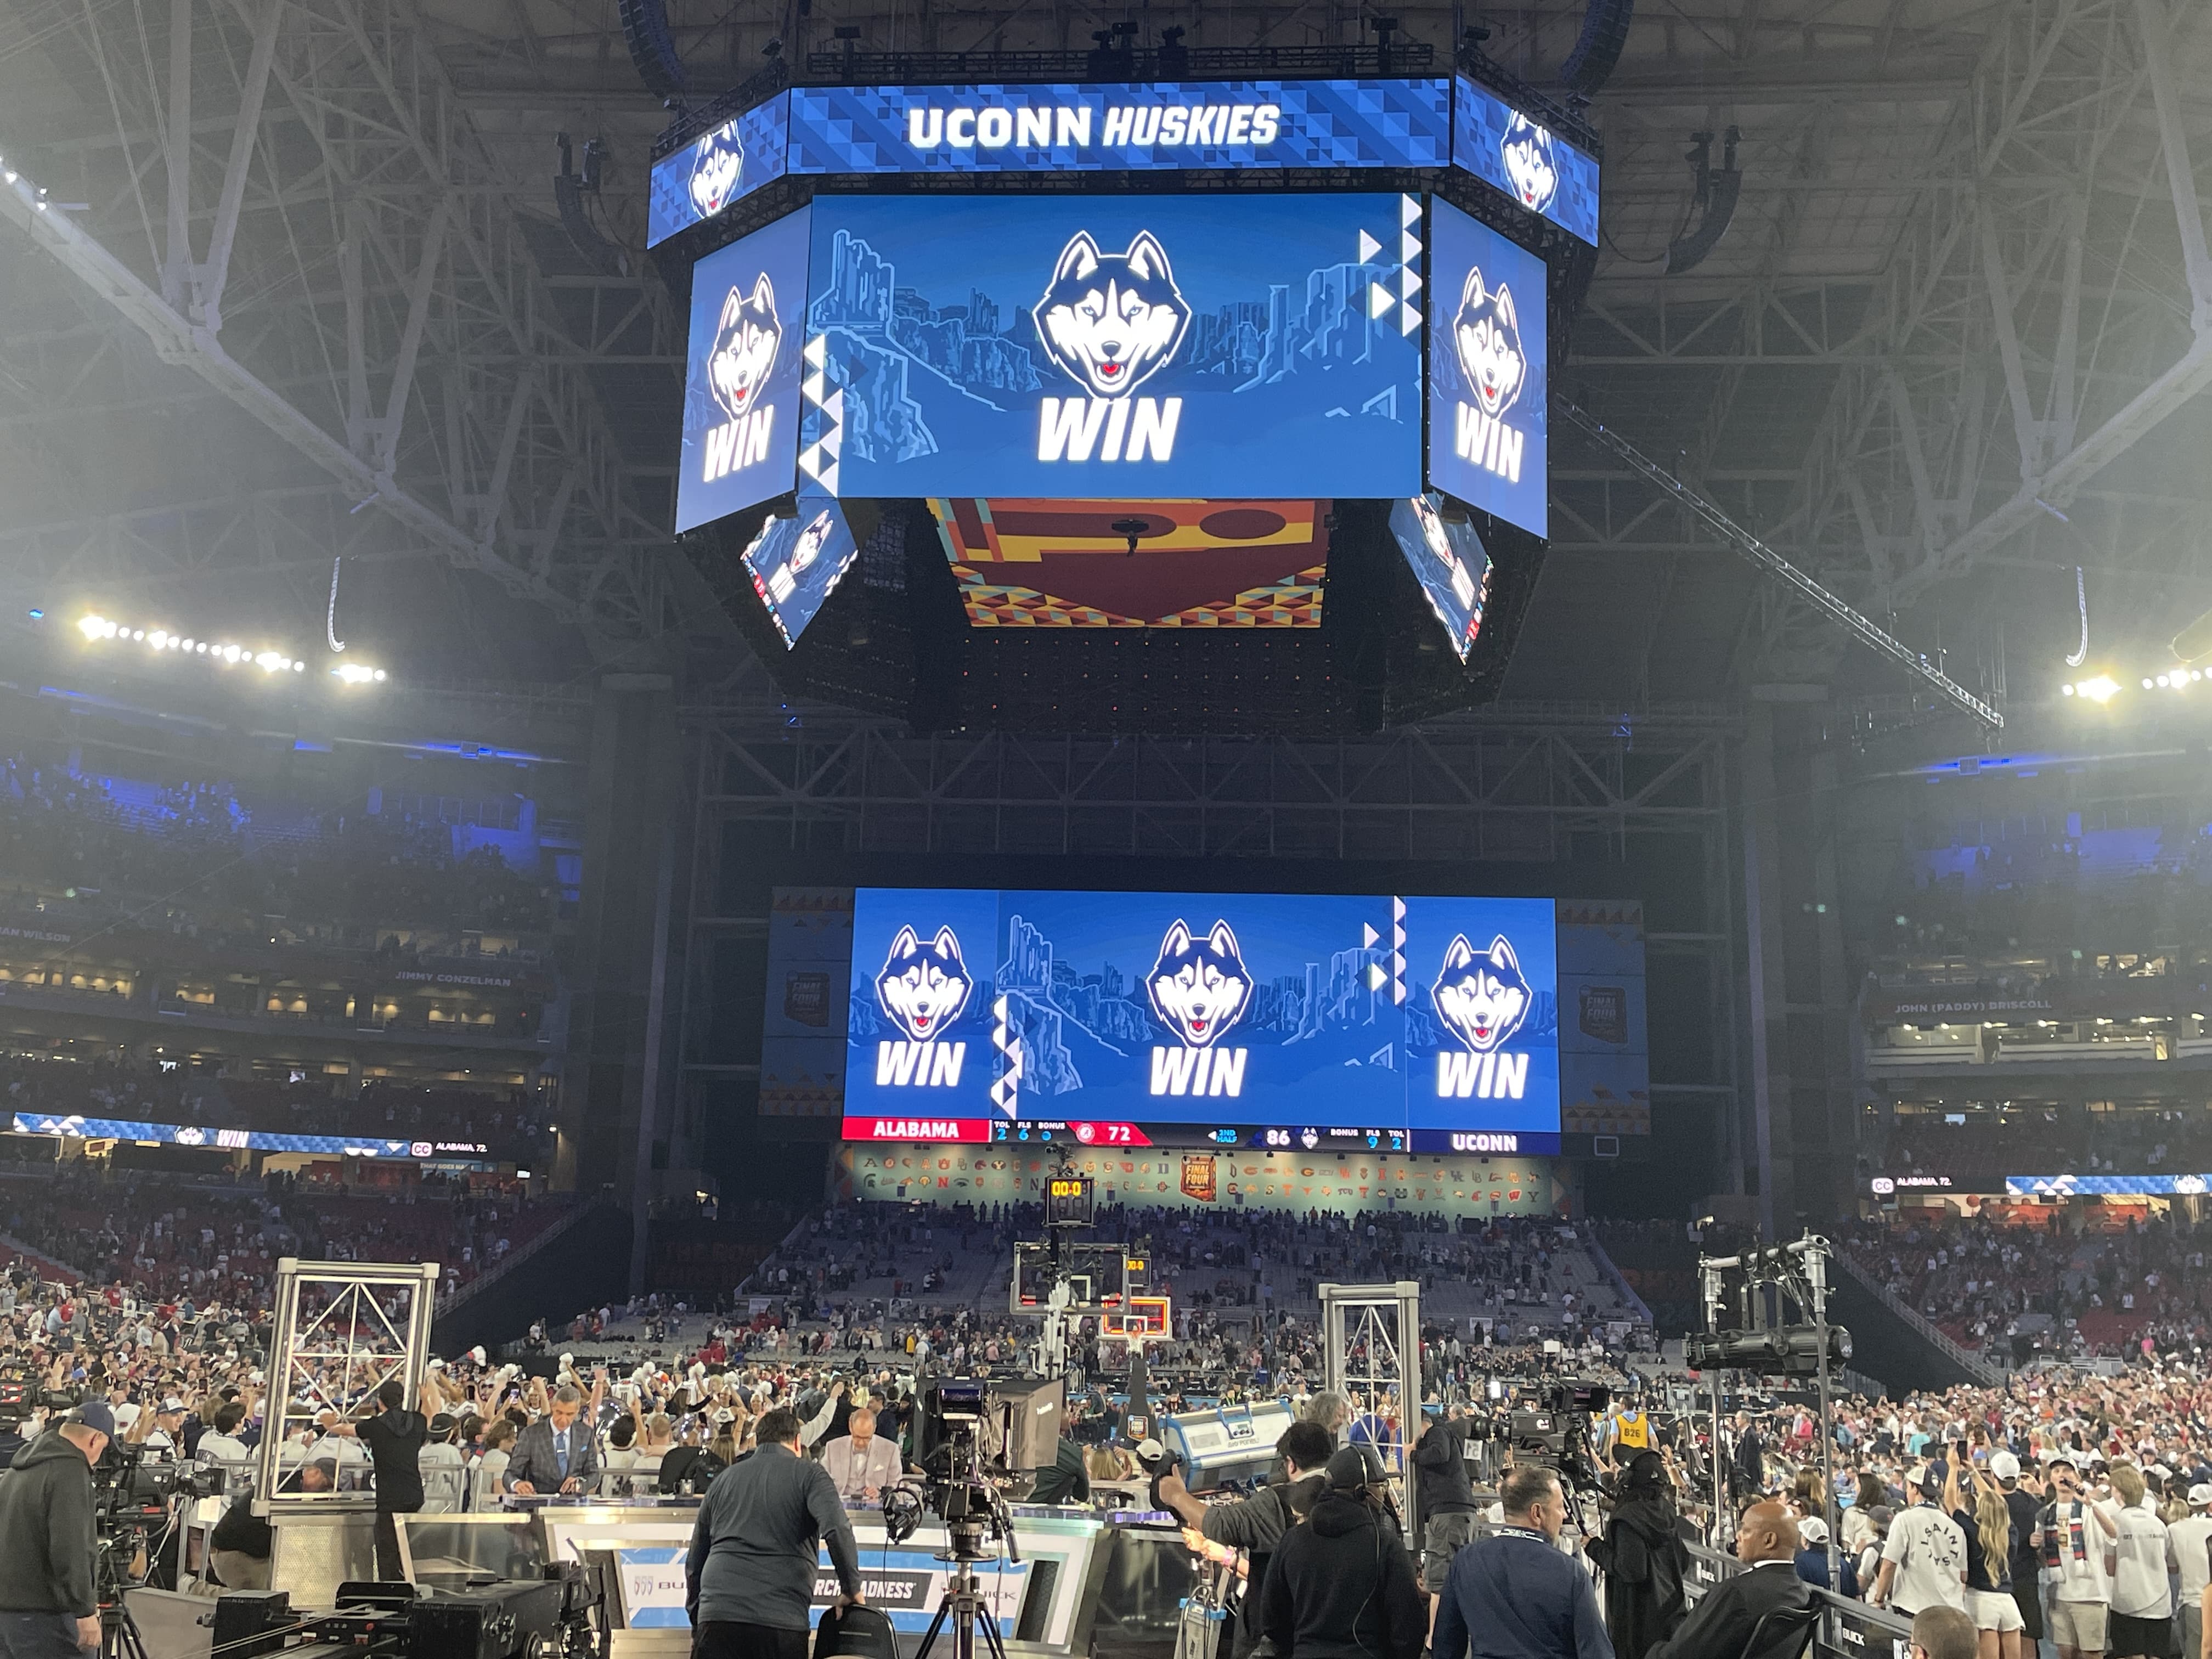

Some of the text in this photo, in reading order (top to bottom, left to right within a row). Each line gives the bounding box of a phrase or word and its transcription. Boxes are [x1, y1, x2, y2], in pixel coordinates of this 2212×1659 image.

[909, 104, 1280, 148] UCONN HUSKIES
[1038, 397, 1182, 461] WIN
[704, 405, 774, 483] WIN
[1456, 401, 1523, 483] WIN
[23, 930, 71, 942] WILSON
[395, 971, 511, 986] JIMMY CONZELMAN
[1895, 1000, 2052, 1013] JOHN (PADDY) DRISCOLL
[876, 1041, 966, 1086] WIN
[1150, 1047, 1247, 1097] WIN
[1438, 1052, 1529, 1099] WIN
[217, 1128, 250, 1148] WIN
[873, 1121, 960, 1138] ALABAMA
[997, 1128, 1029, 1141] 2 6
[1108, 1126, 1131, 1141] 72
[1267, 1129, 1290, 1146] 86
[414, 1145, 429, 1154] CC
[1367, 1136, 1402, 1150] 9 2
[1453, 1135, 1517, 1152] UCONN
[1186, 1165, 1210, 1175] FINAL
[1186, 1175, 1209, 1186] FOUR
[1875, 1181, 1891, 1190] CC
[1624, 1427, 1641, 1438] B26
[1701, 1569, 1716, 1583] BUICK
[813, 1578, 914, 1599] RCH ADNESS
[1842, 1627, 1865, 1646] BUICK
